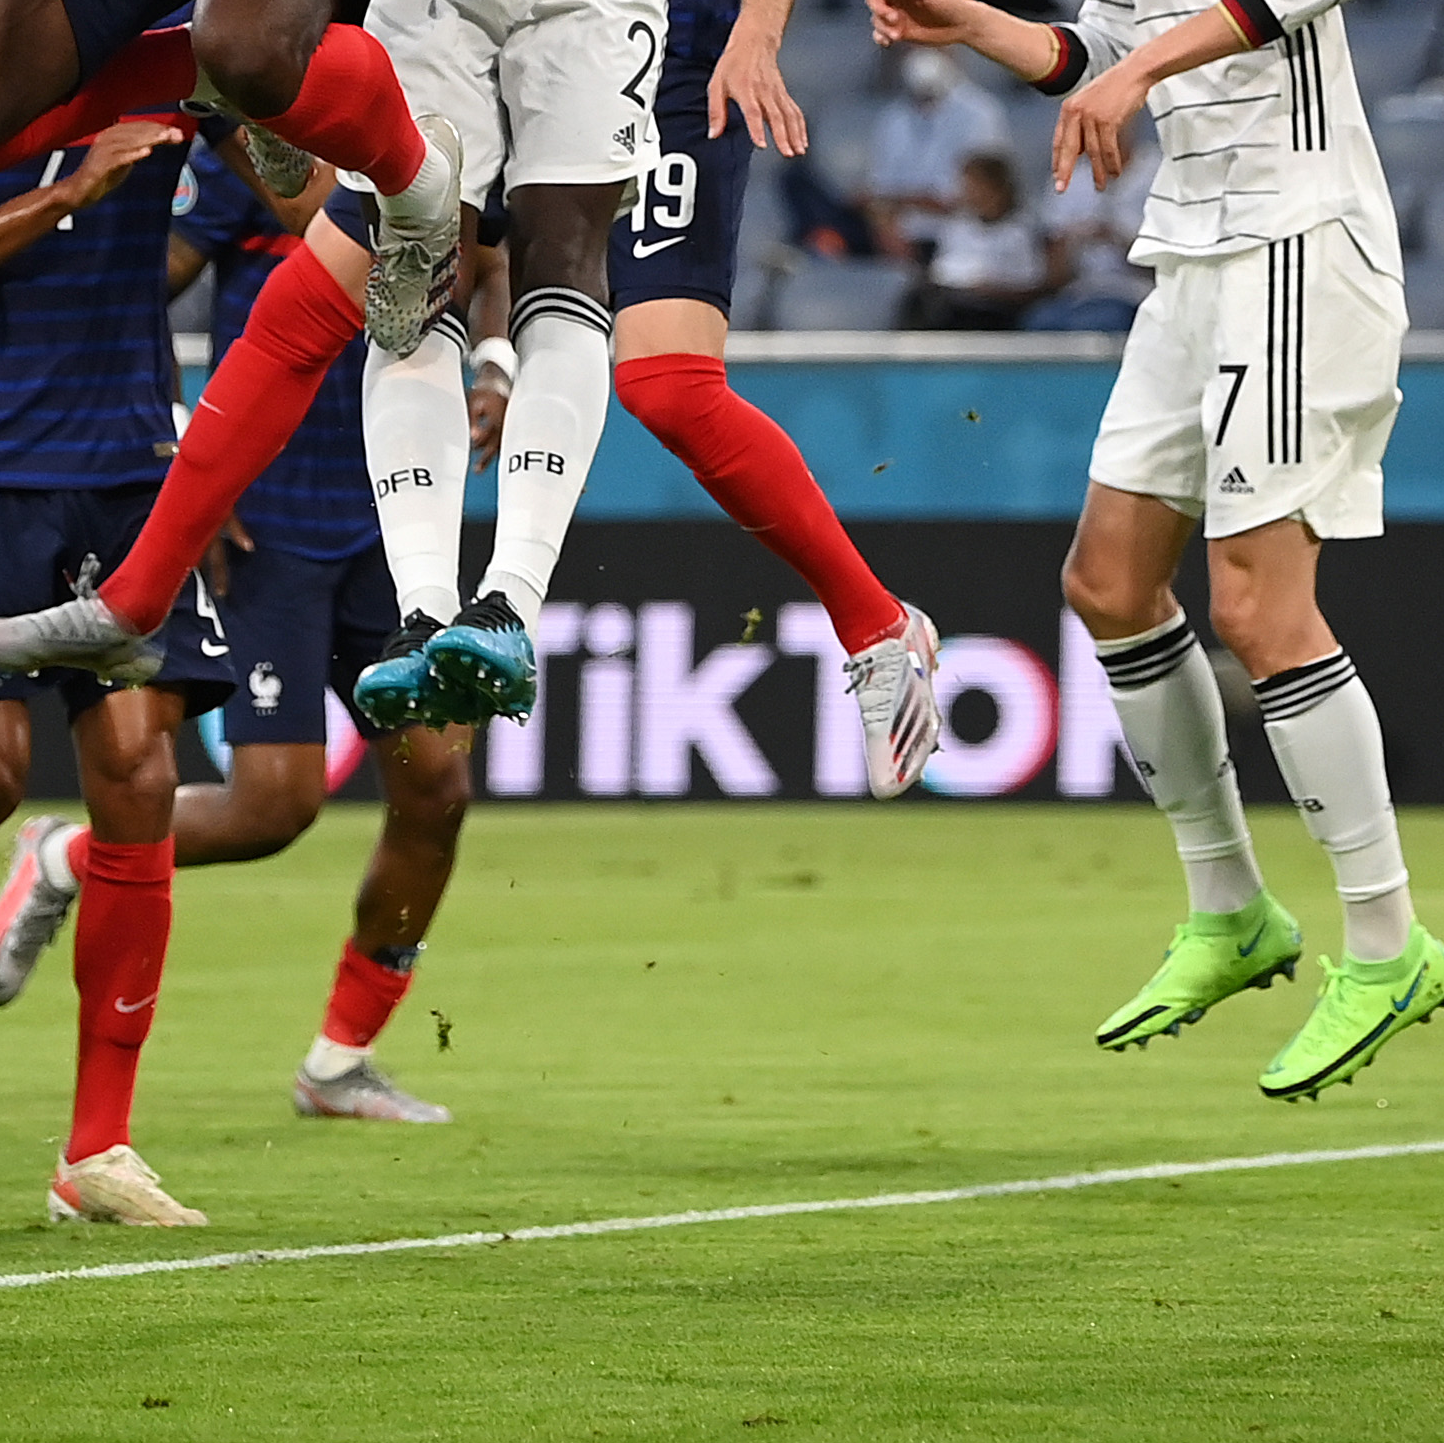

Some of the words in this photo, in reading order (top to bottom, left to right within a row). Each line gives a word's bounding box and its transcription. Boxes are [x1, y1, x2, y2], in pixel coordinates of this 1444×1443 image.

[620, 20, 656, 110] 2
[631, 152, 697, 233] 19
[1215, 364, 1249, 447] 7
[376, 467, 433, 499] DFB
[509, 450, 565, 475] DFB
